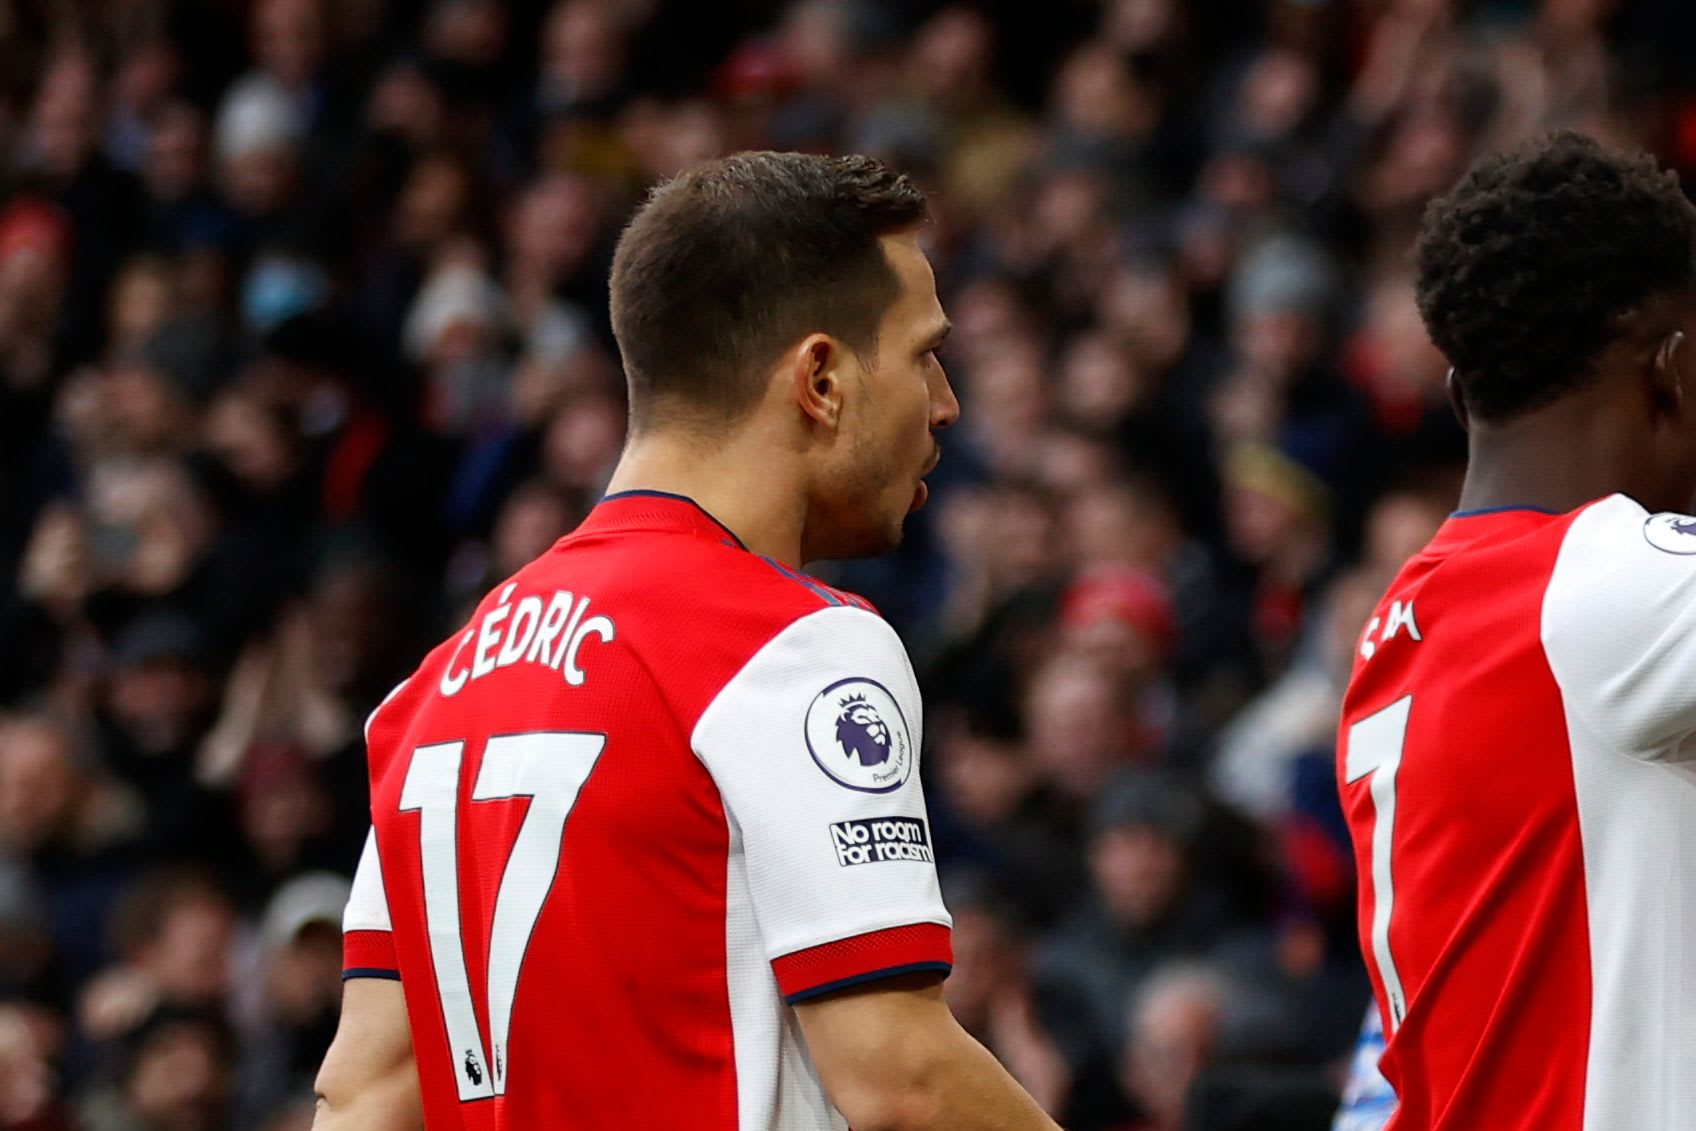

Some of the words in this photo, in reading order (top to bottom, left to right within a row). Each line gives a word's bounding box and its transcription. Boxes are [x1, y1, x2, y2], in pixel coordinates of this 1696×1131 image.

[438, 582, 615, 697] CÉDRIC
[831, 820, 870, 845] No
[871, 821, 923, 844] room
[837, 842, 873, 867] for
[875, 842, 934, 863] racism
[1344, 693, 1413, 1036] 7
[398, 731, 607, 1101] 17
